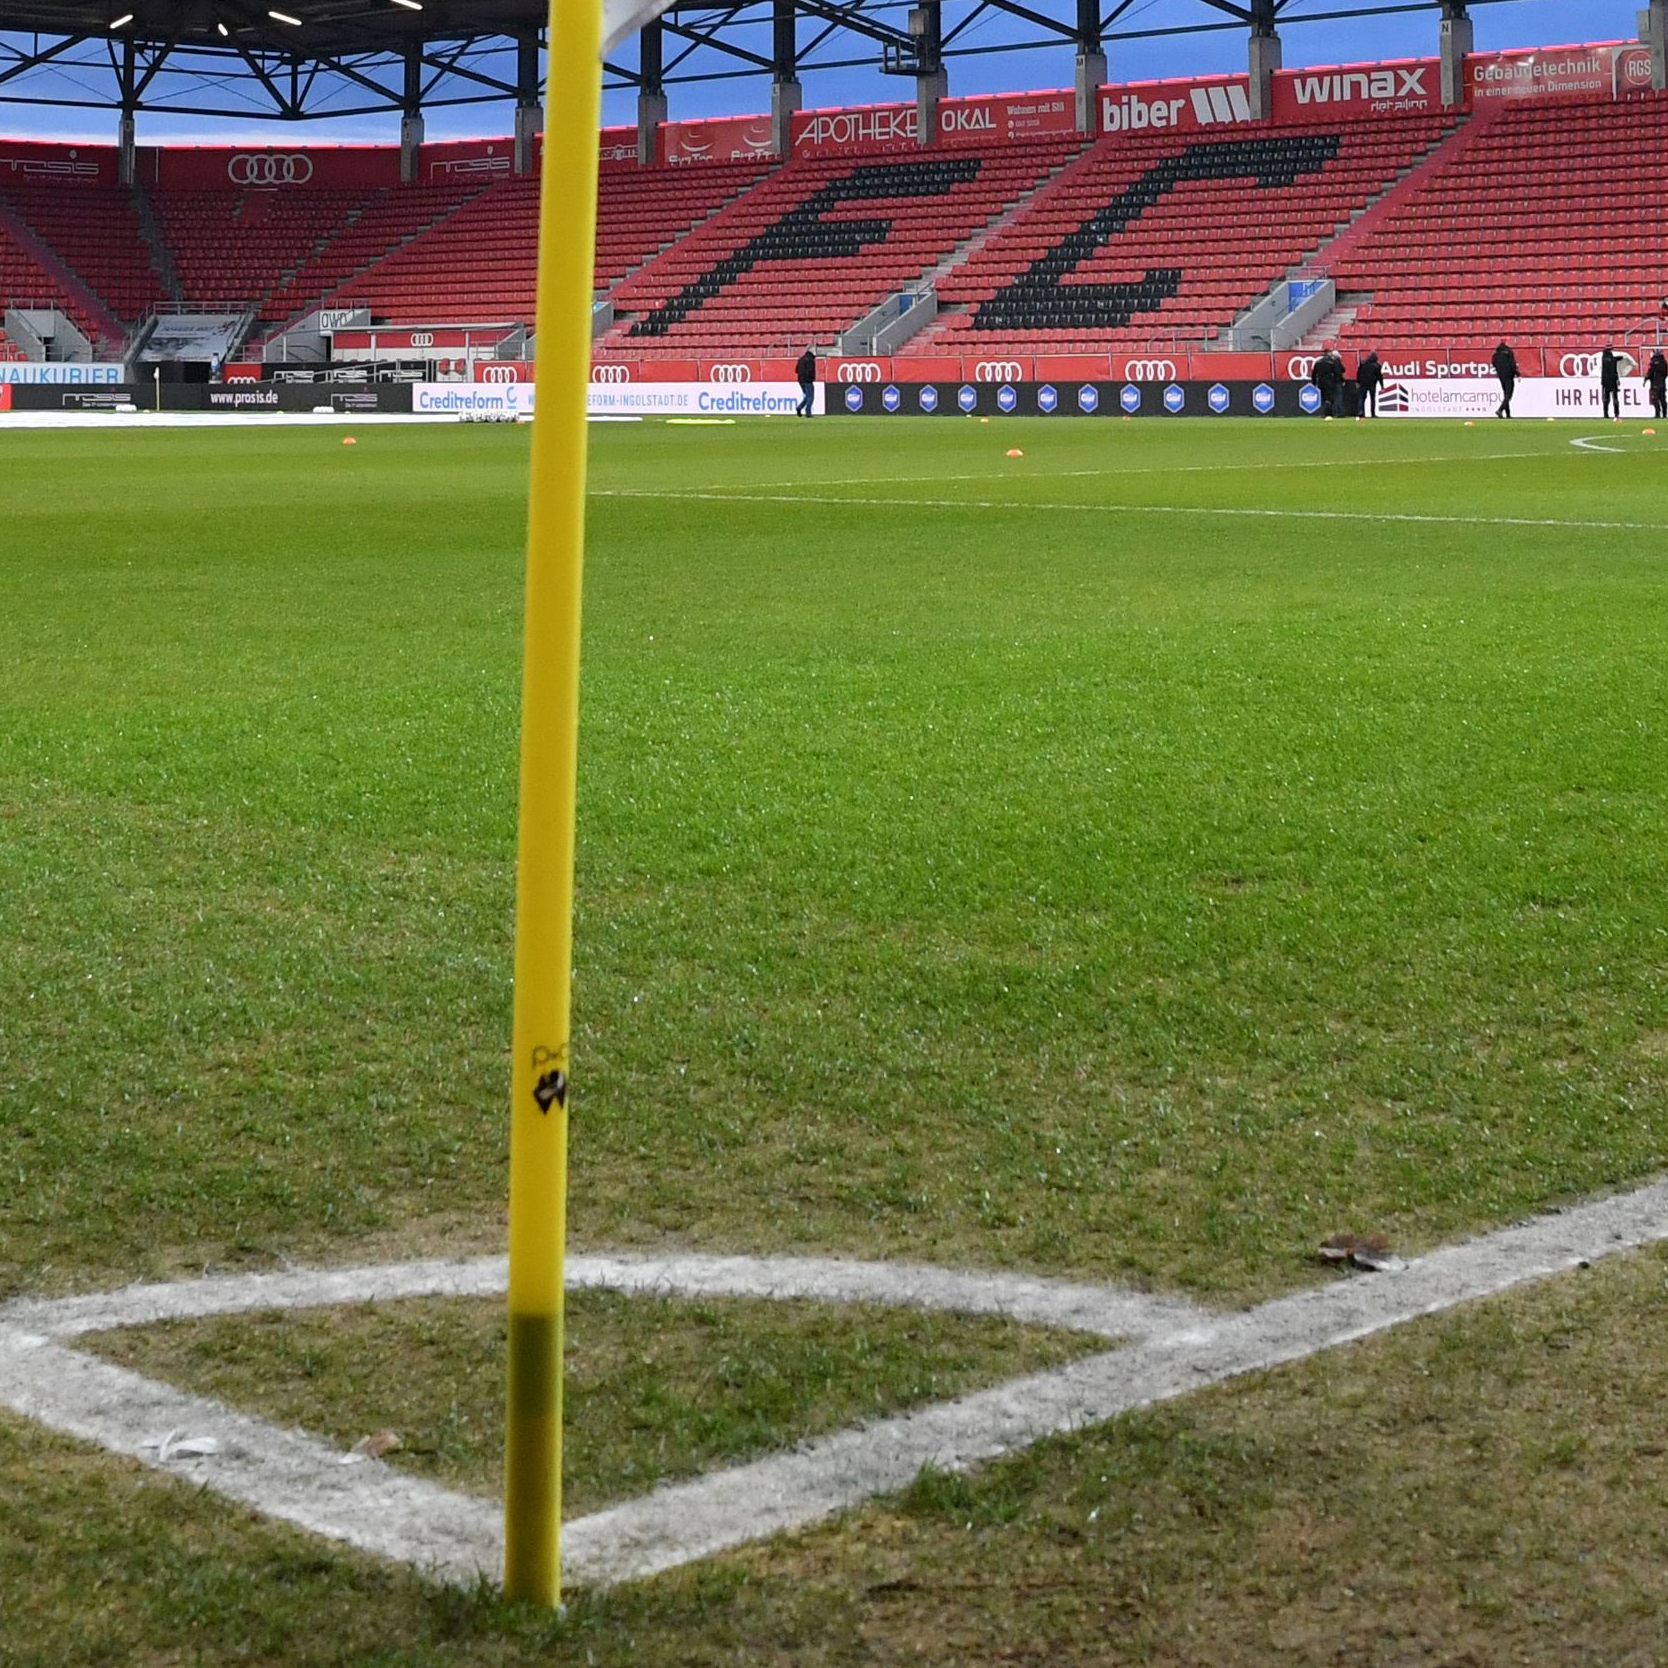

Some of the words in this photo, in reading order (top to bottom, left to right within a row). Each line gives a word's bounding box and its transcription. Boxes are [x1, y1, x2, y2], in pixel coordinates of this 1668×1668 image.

[1441, 23, 1449, 32] N
[1474, 57, 1601, 82] Gebäudetechnik
[1628, 59, 1652, 77] RGS
[1294, 68, 1428, 104] winax
[1474, 88, 1484, 97] in
[1547, 80, 1602, 92] Dimension
[941, 107, 997, 132] OKAL
[1102, 95, 1186, 132] biber
[795, 109, 918, 147] APOTHEKE
[1381, 361, 1421, 376] Audi
[1425, 360, 1519, 379] Sportpa
[210, 391, 278, 407] www.prosis.de
[420, 391, 503, 409] Creditreform
[699, 392, 798, 412] Creditreform
[1412, 387, 1504, 407] hotelamcampu
[1555, 388, 1582, 406] IHR
[1590, 388, 1641, 406] HEL
